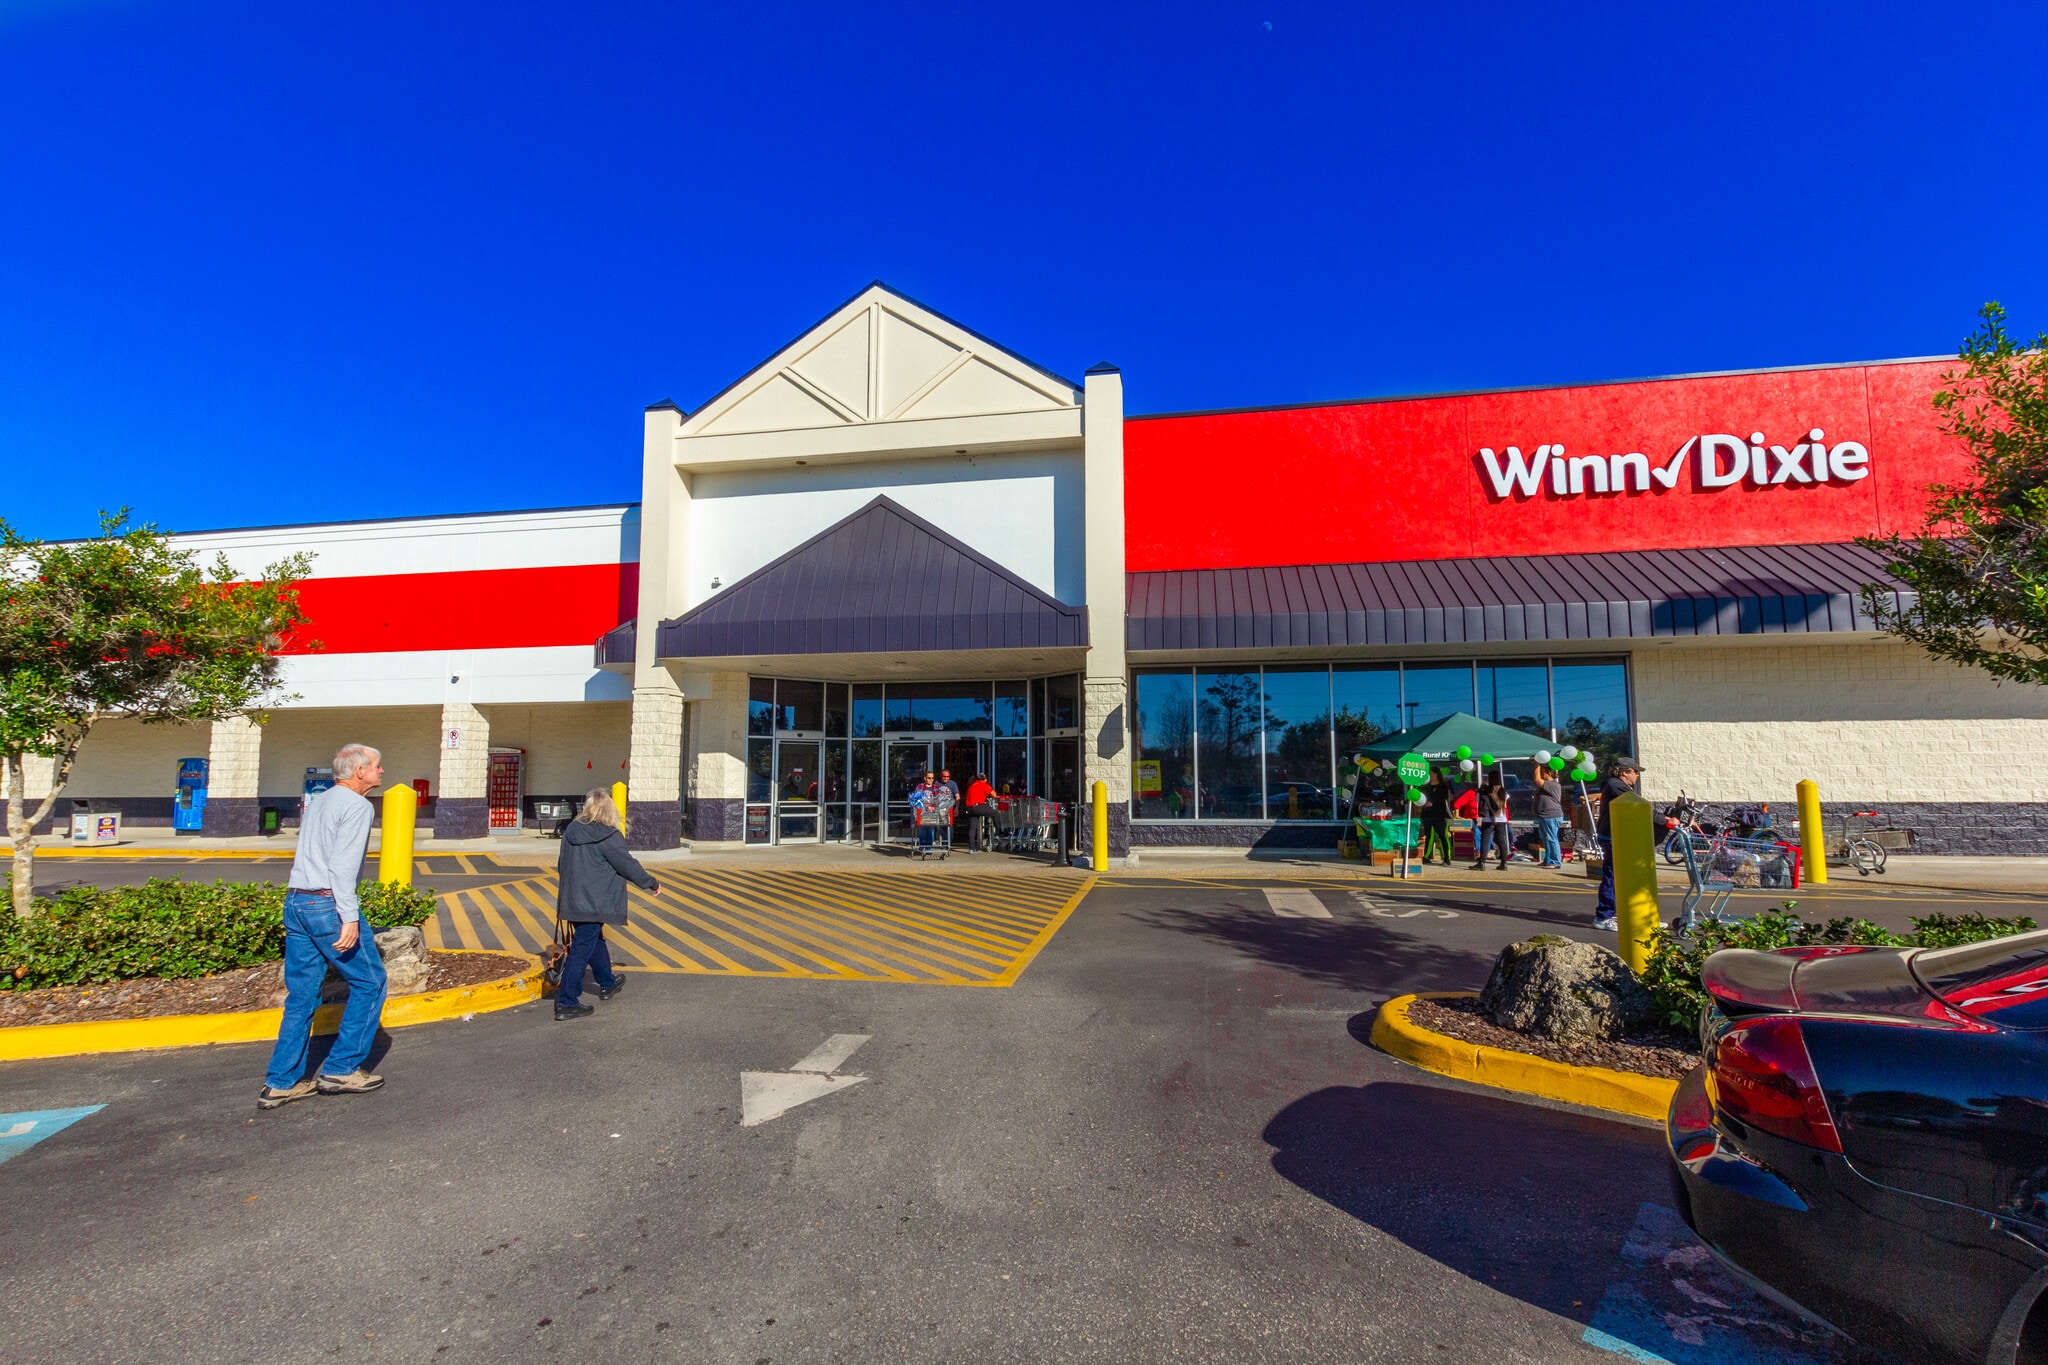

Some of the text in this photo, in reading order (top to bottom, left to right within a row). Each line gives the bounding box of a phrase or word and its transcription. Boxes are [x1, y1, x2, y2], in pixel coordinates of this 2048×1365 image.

[1479, 428, 1869, 497] Winn Dixie
[1400, 767, 1426, 778] STOP
[1347, 890, 1460, 919] STOP
